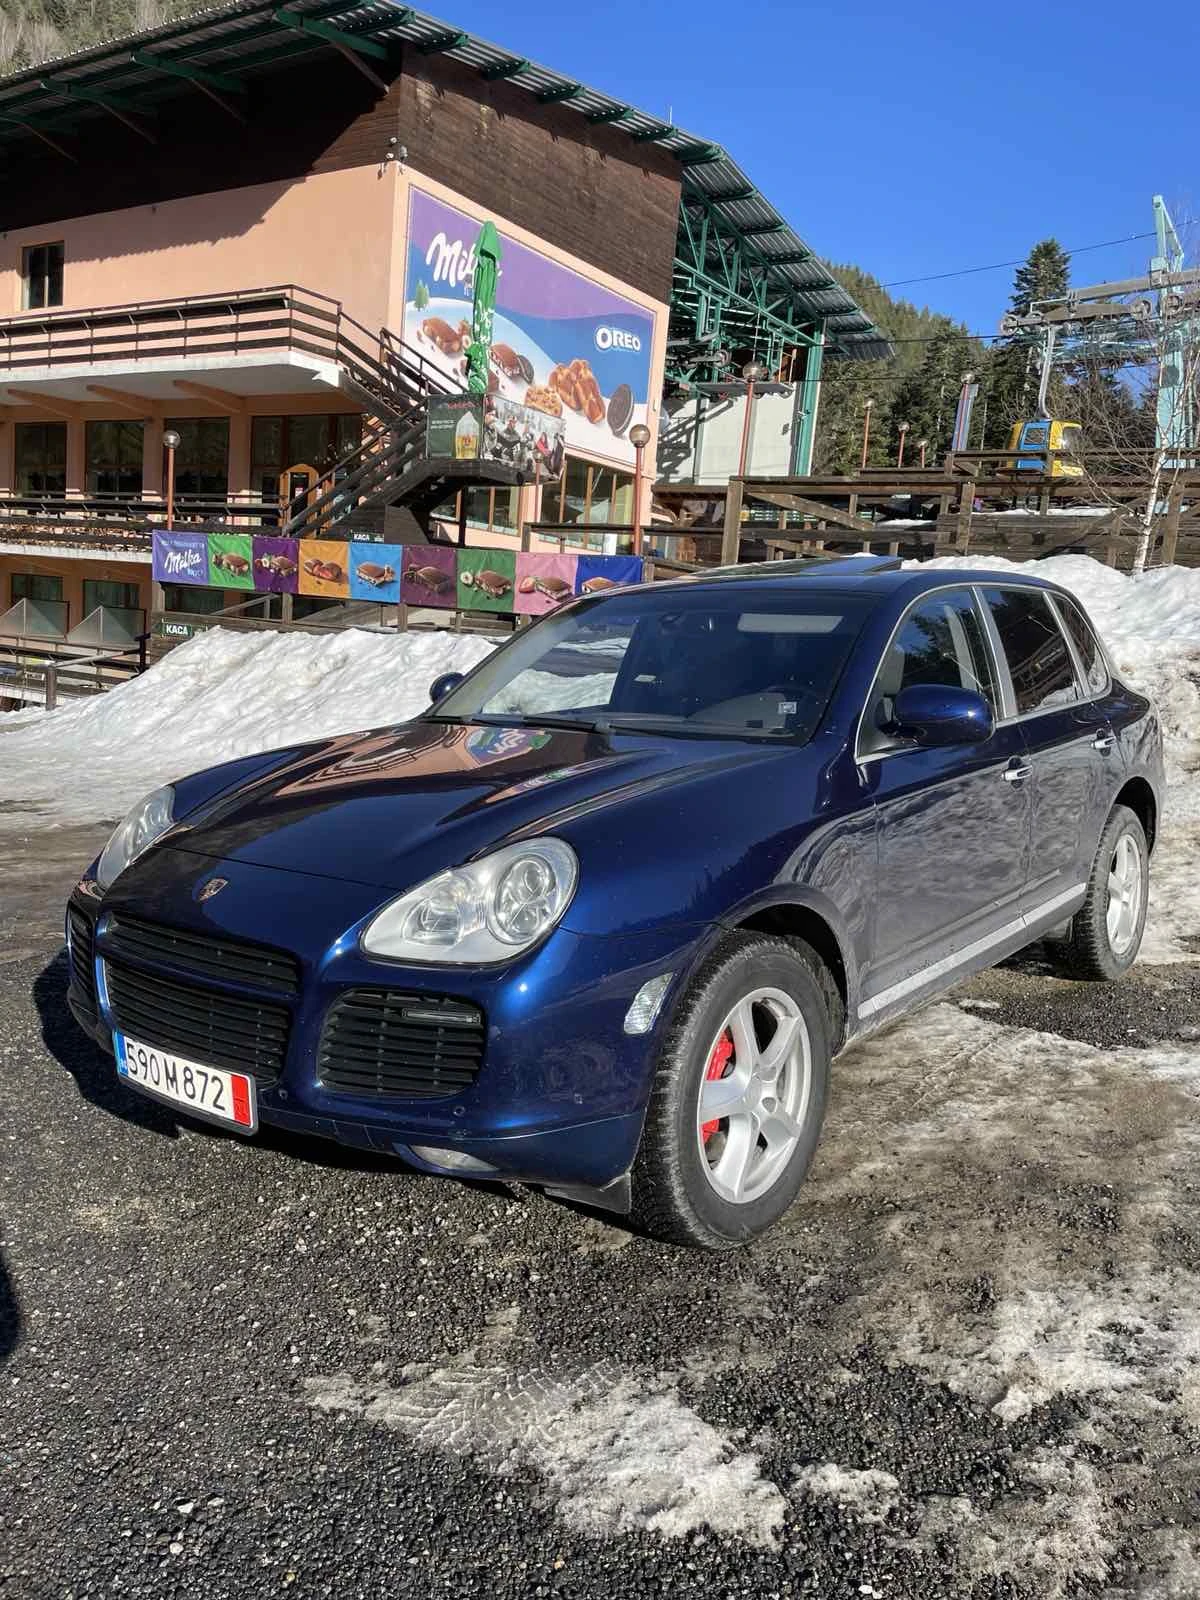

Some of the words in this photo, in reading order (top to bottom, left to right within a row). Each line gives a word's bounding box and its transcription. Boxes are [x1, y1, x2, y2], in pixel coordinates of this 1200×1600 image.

[425, 231, 503, 288] Mil
[595, 327, 641, 352] OREO
[164, 549, 202, 574] Milka
[166, 624, 189, 635] КАСА
